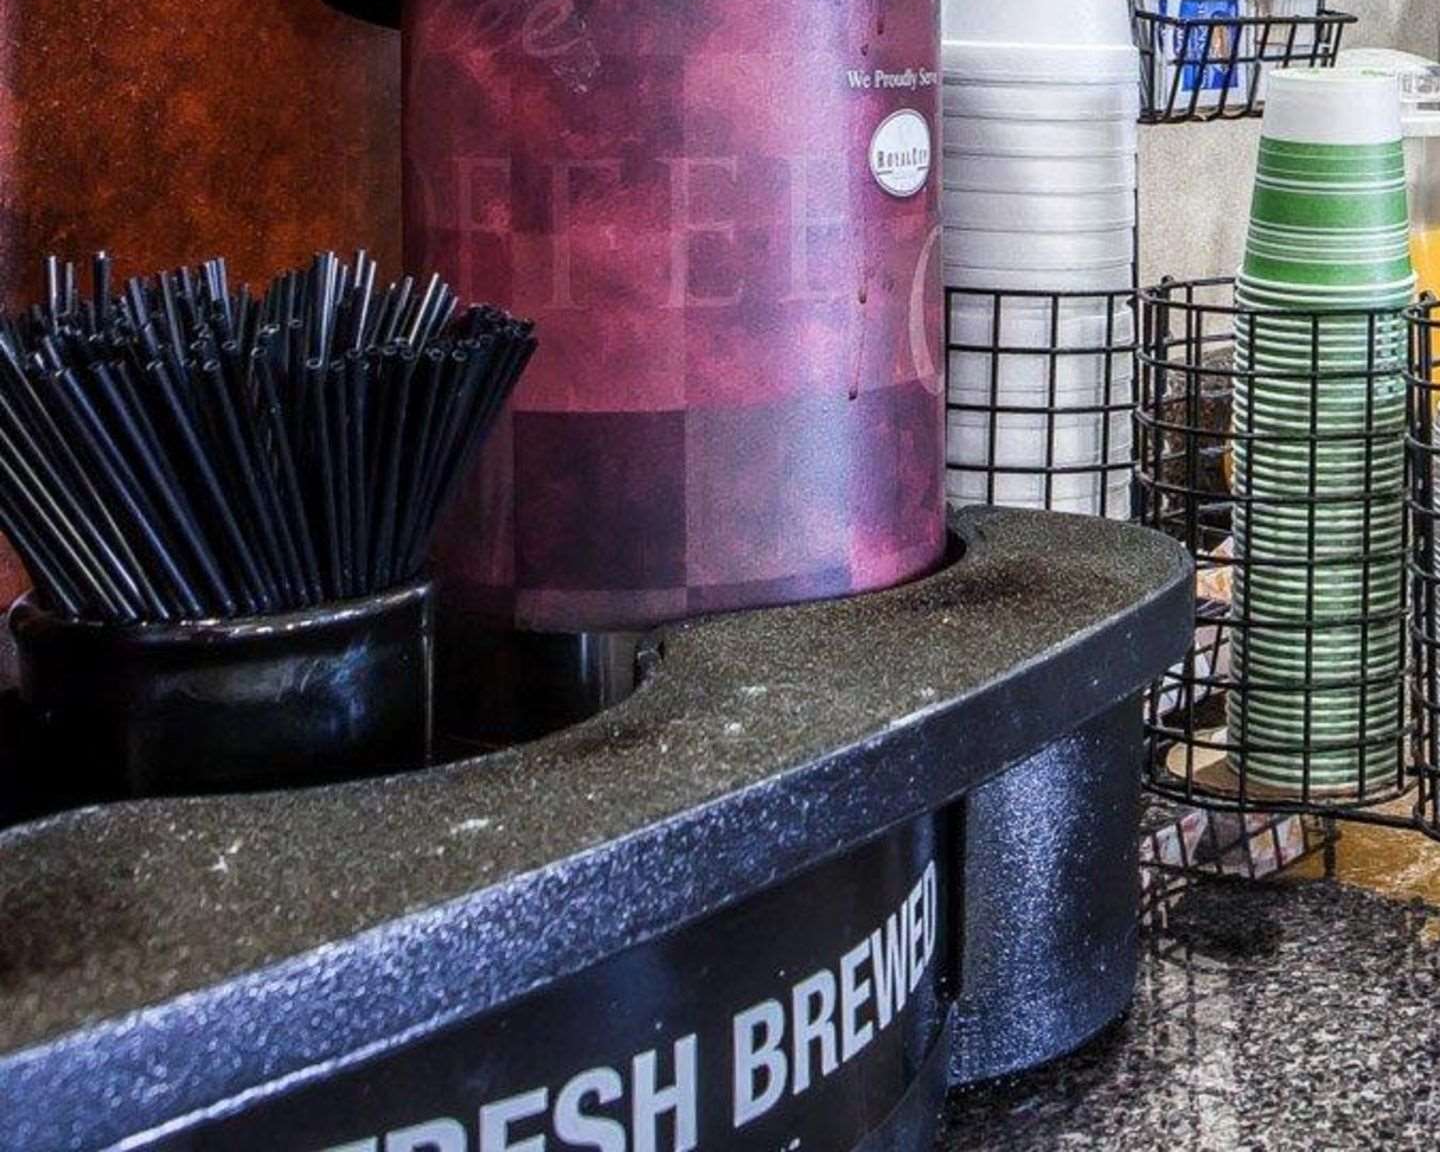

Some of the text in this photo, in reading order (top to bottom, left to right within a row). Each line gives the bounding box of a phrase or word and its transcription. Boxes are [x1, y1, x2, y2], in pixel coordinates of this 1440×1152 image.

[847, 70, 871, 88] We
[874, 69, 917, 91] Proudly
[732, 859, 937, 1129] BREWED
